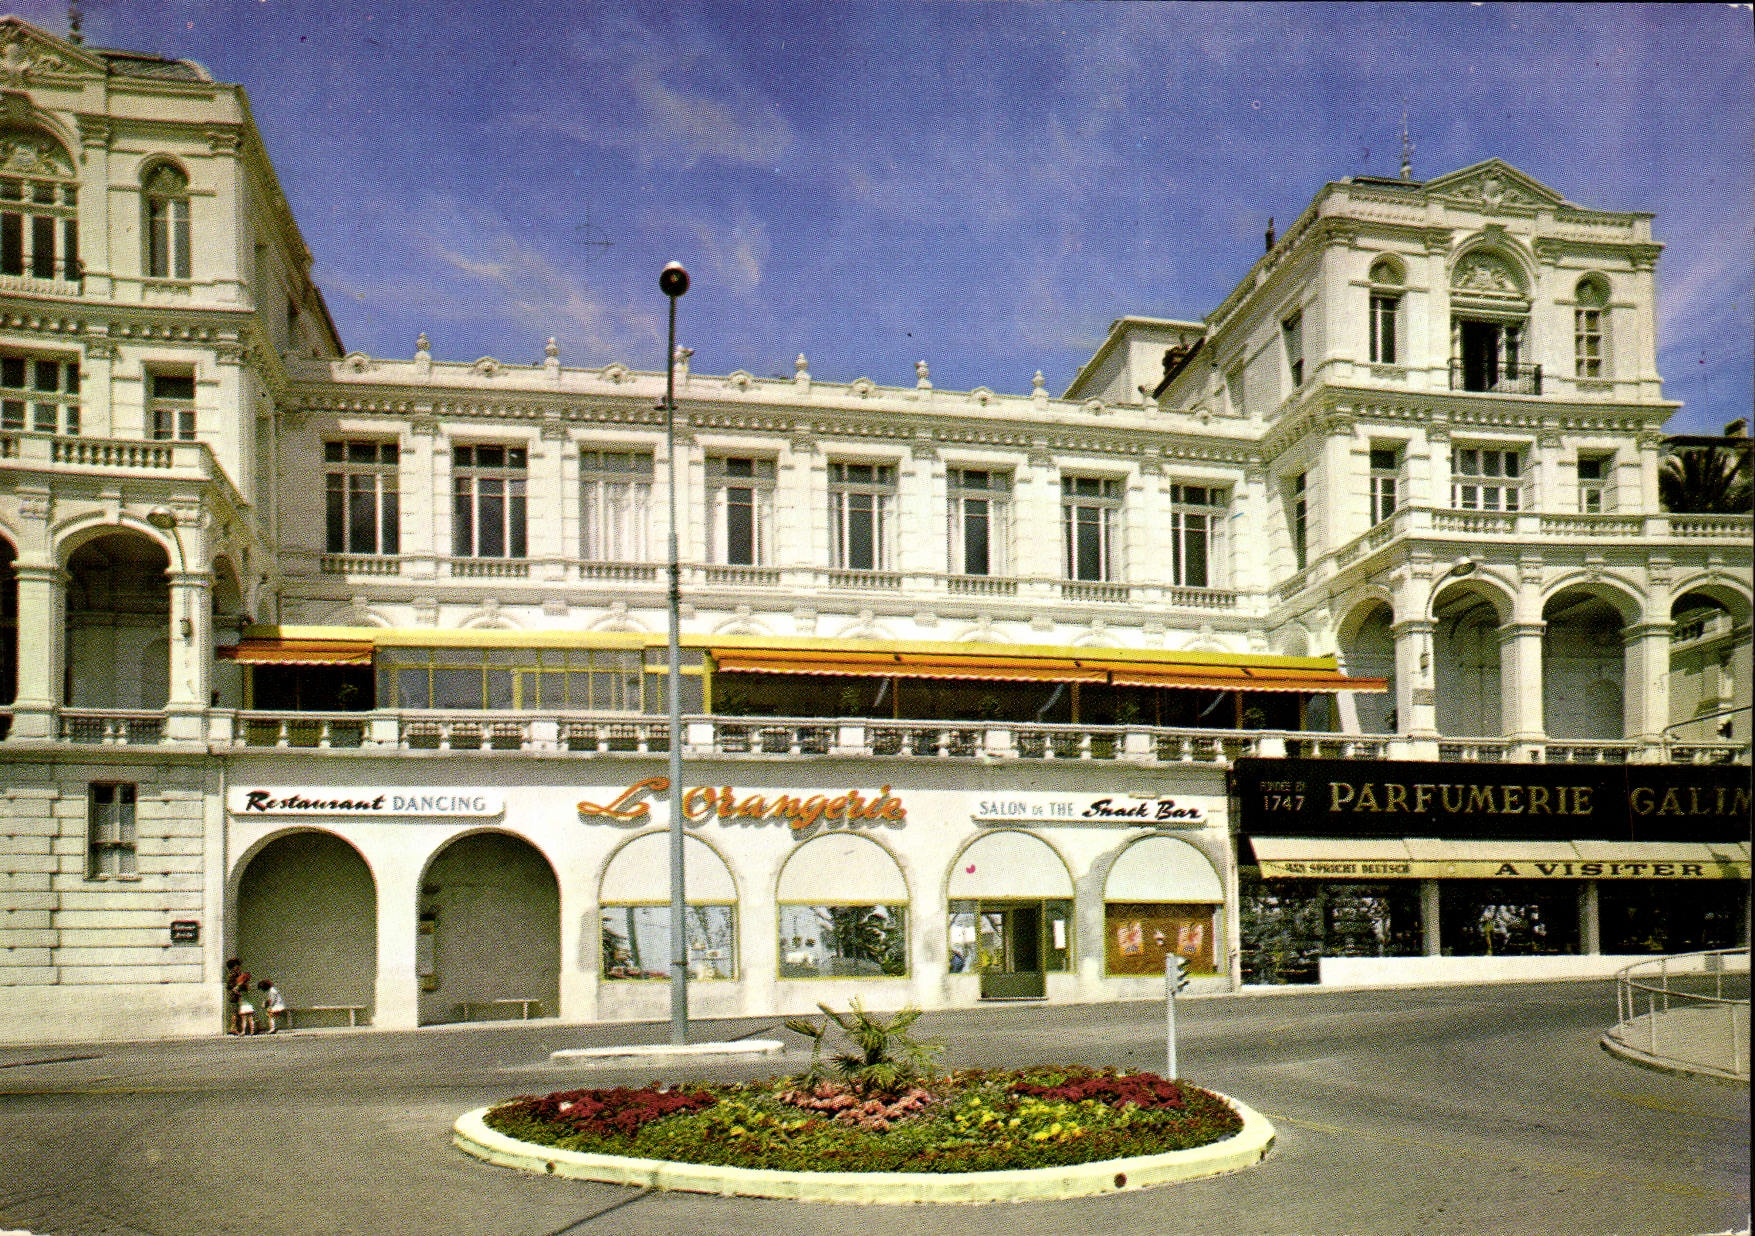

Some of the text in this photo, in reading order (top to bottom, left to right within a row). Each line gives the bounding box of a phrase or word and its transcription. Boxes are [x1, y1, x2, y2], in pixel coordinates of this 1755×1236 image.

[246, 789, 486, 812] Restaurant DANCING
[1263, 795, 1305, 811] 1747
[1328, 782, 1593, 815] PARFUMERIE
[980, 801, 1027, 815] SALON
[1032, 805, 1043, 816] DE
[1082, 799, 1149, 818] Snack
[1155, 800, 1203, 820] Bar
[1495, 864, 1703, 876] A VISITER
